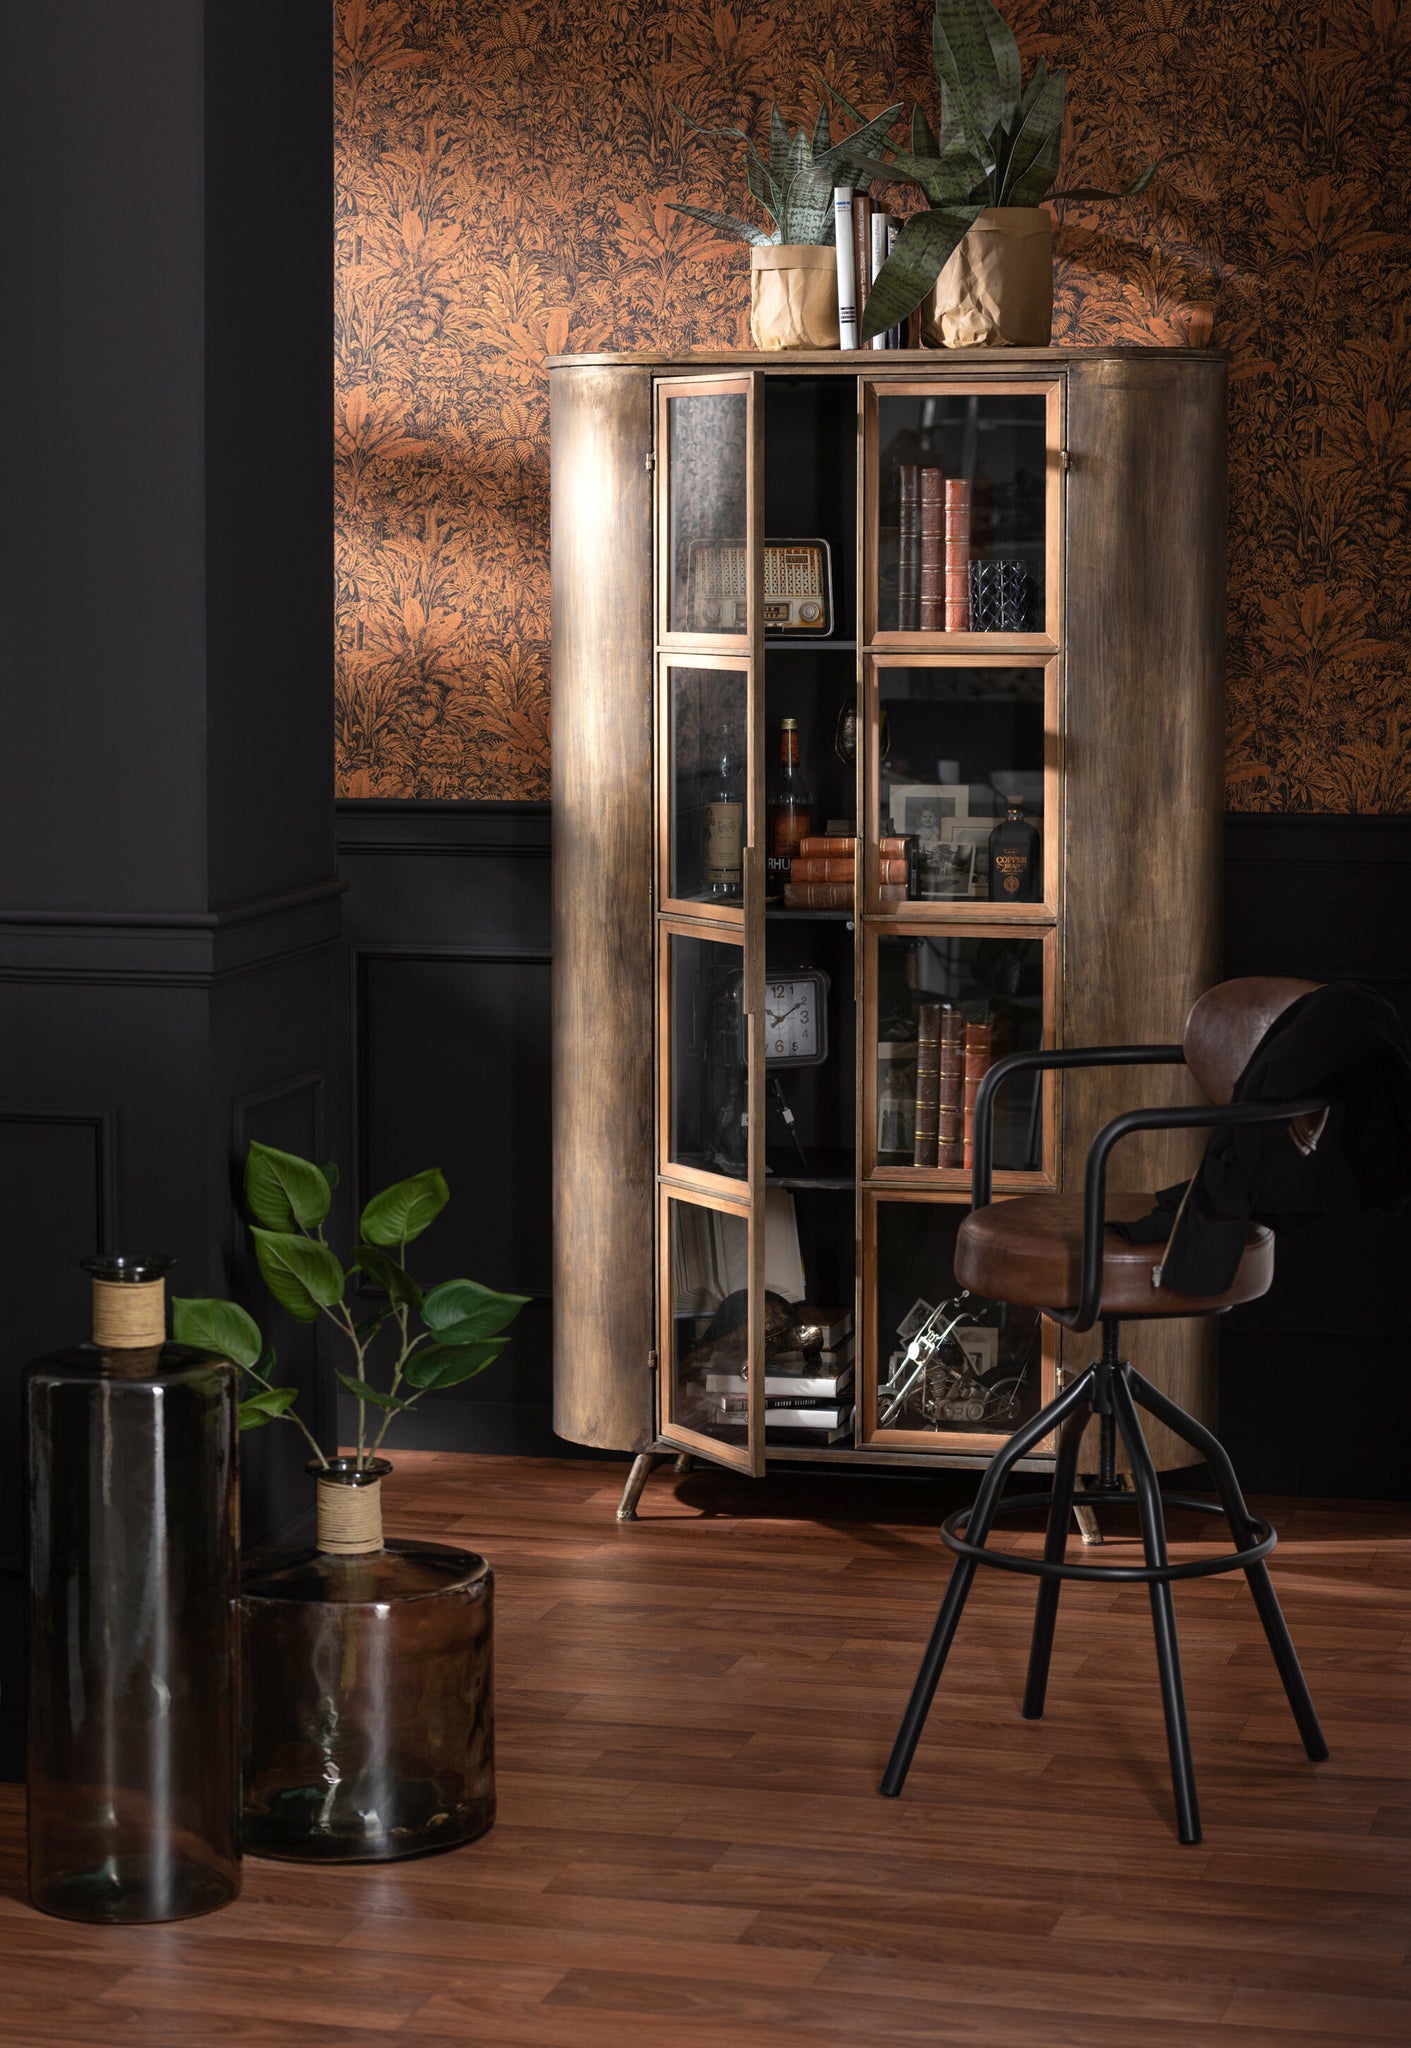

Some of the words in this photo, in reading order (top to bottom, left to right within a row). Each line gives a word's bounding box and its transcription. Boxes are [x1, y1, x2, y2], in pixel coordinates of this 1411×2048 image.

[771, 985, 785, 999] 12
[790, 985, 794, 995] 1
[801, 996, 808, 1006] 2
[800, 1010, 809, 1024] 3
[802, 1030, 808, 1038] 4
[775, 1039, 784, 1053] 6
[792, 1042, 799, 1051] 5
